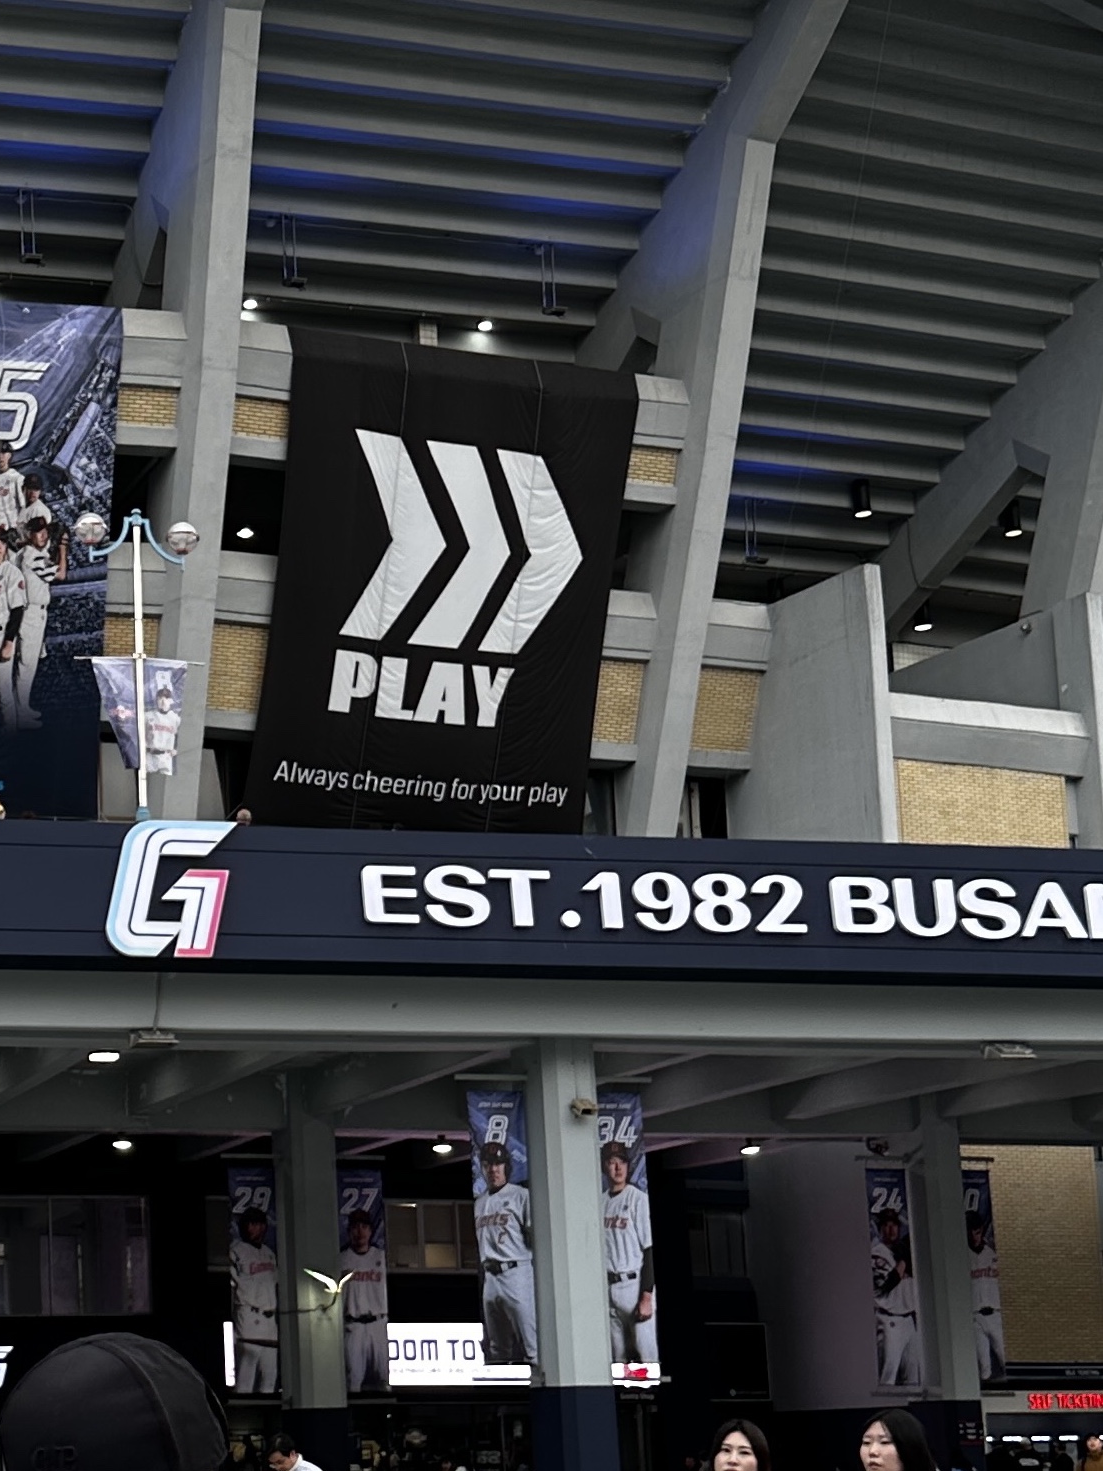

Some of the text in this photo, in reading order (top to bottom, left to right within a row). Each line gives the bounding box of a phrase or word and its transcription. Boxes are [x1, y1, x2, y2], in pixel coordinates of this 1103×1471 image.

[327, 648, 515, 728] PLAY
[273, 759, 569, 808] Always cheering for your play
[485, 1115, 509, 1144] 8
[598, 1115, 638, 1148] 34
[232, 1186, 272, 1214] 29
[340, 1187, 379, 1214] 27
[870, 1187, 903, 1213] 24
